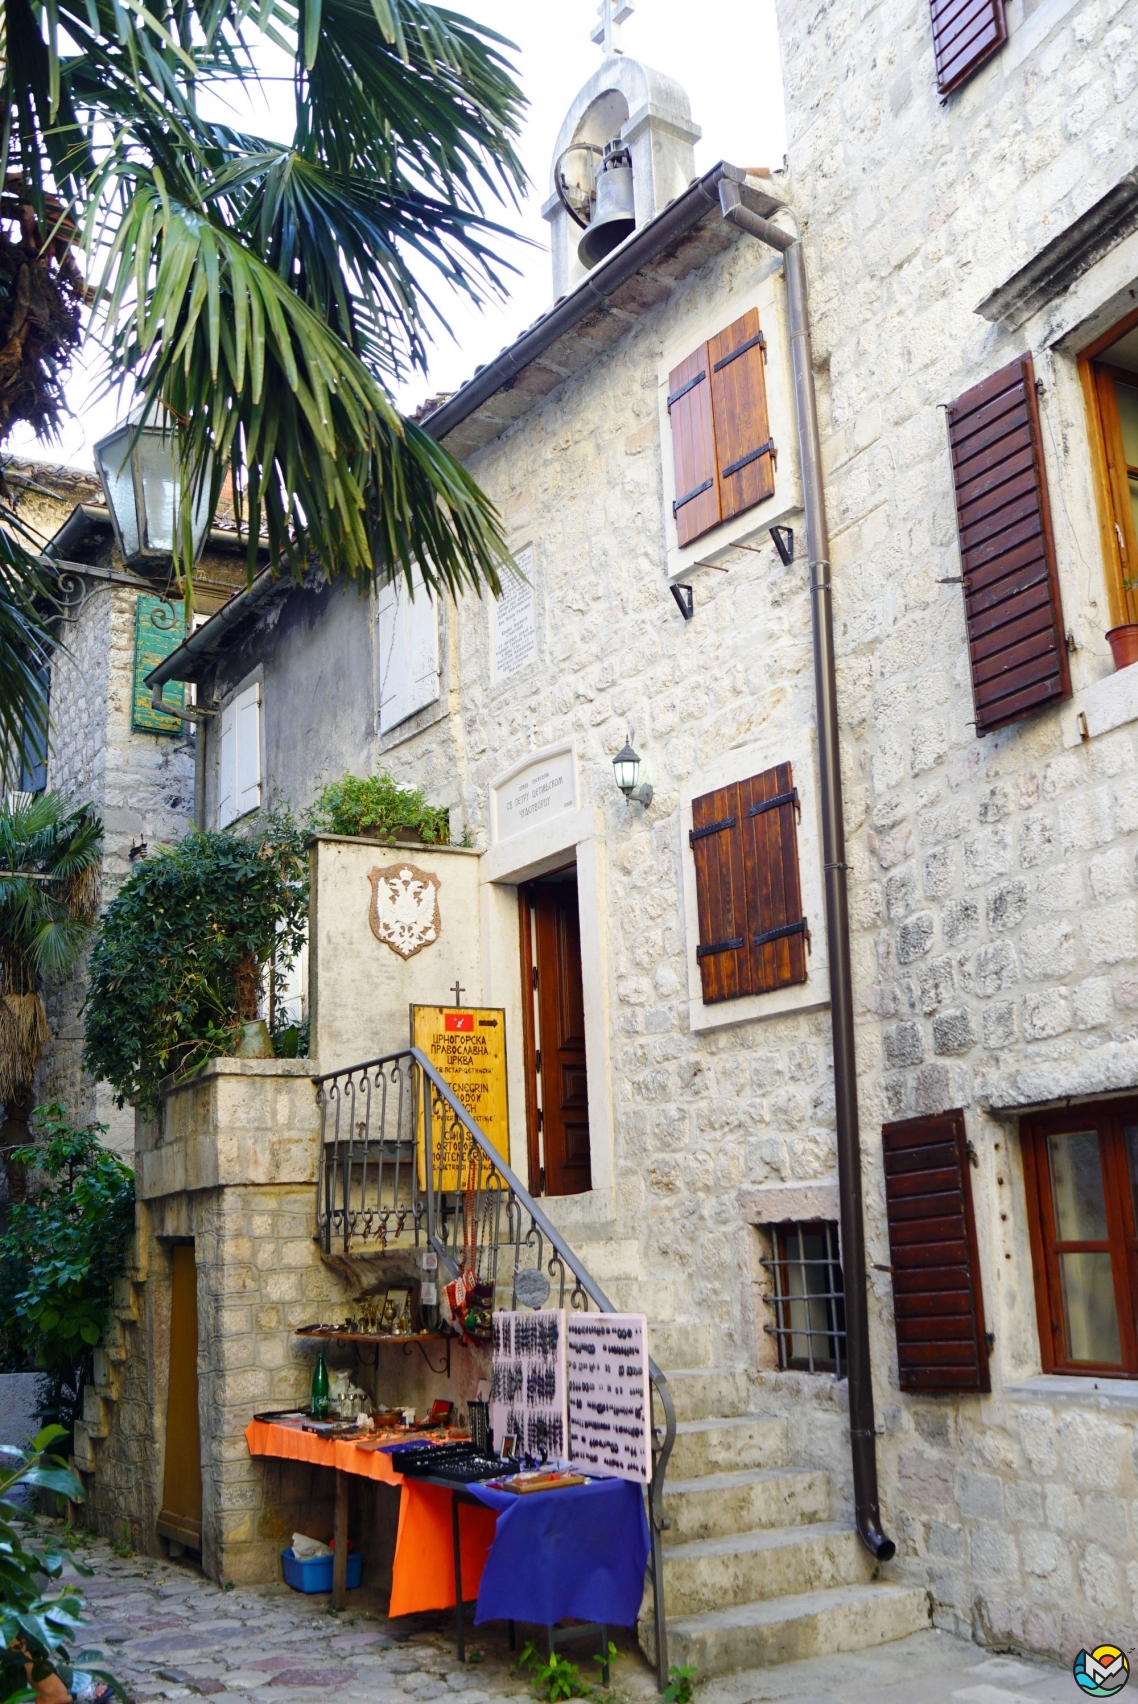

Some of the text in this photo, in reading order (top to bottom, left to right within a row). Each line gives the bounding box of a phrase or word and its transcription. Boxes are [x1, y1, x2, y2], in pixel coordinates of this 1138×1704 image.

[432, 1034, 487, 1046] ЦРНОГОРСКА
[430, 1044, 489, 1056] ПРАВОСЛАВНА
[447, 1056, 474, 1065] ЦРКВА
[432, 1082, 489, 1092] MTENEGRIN
[444, 1103, 477, 1113] CHCH
